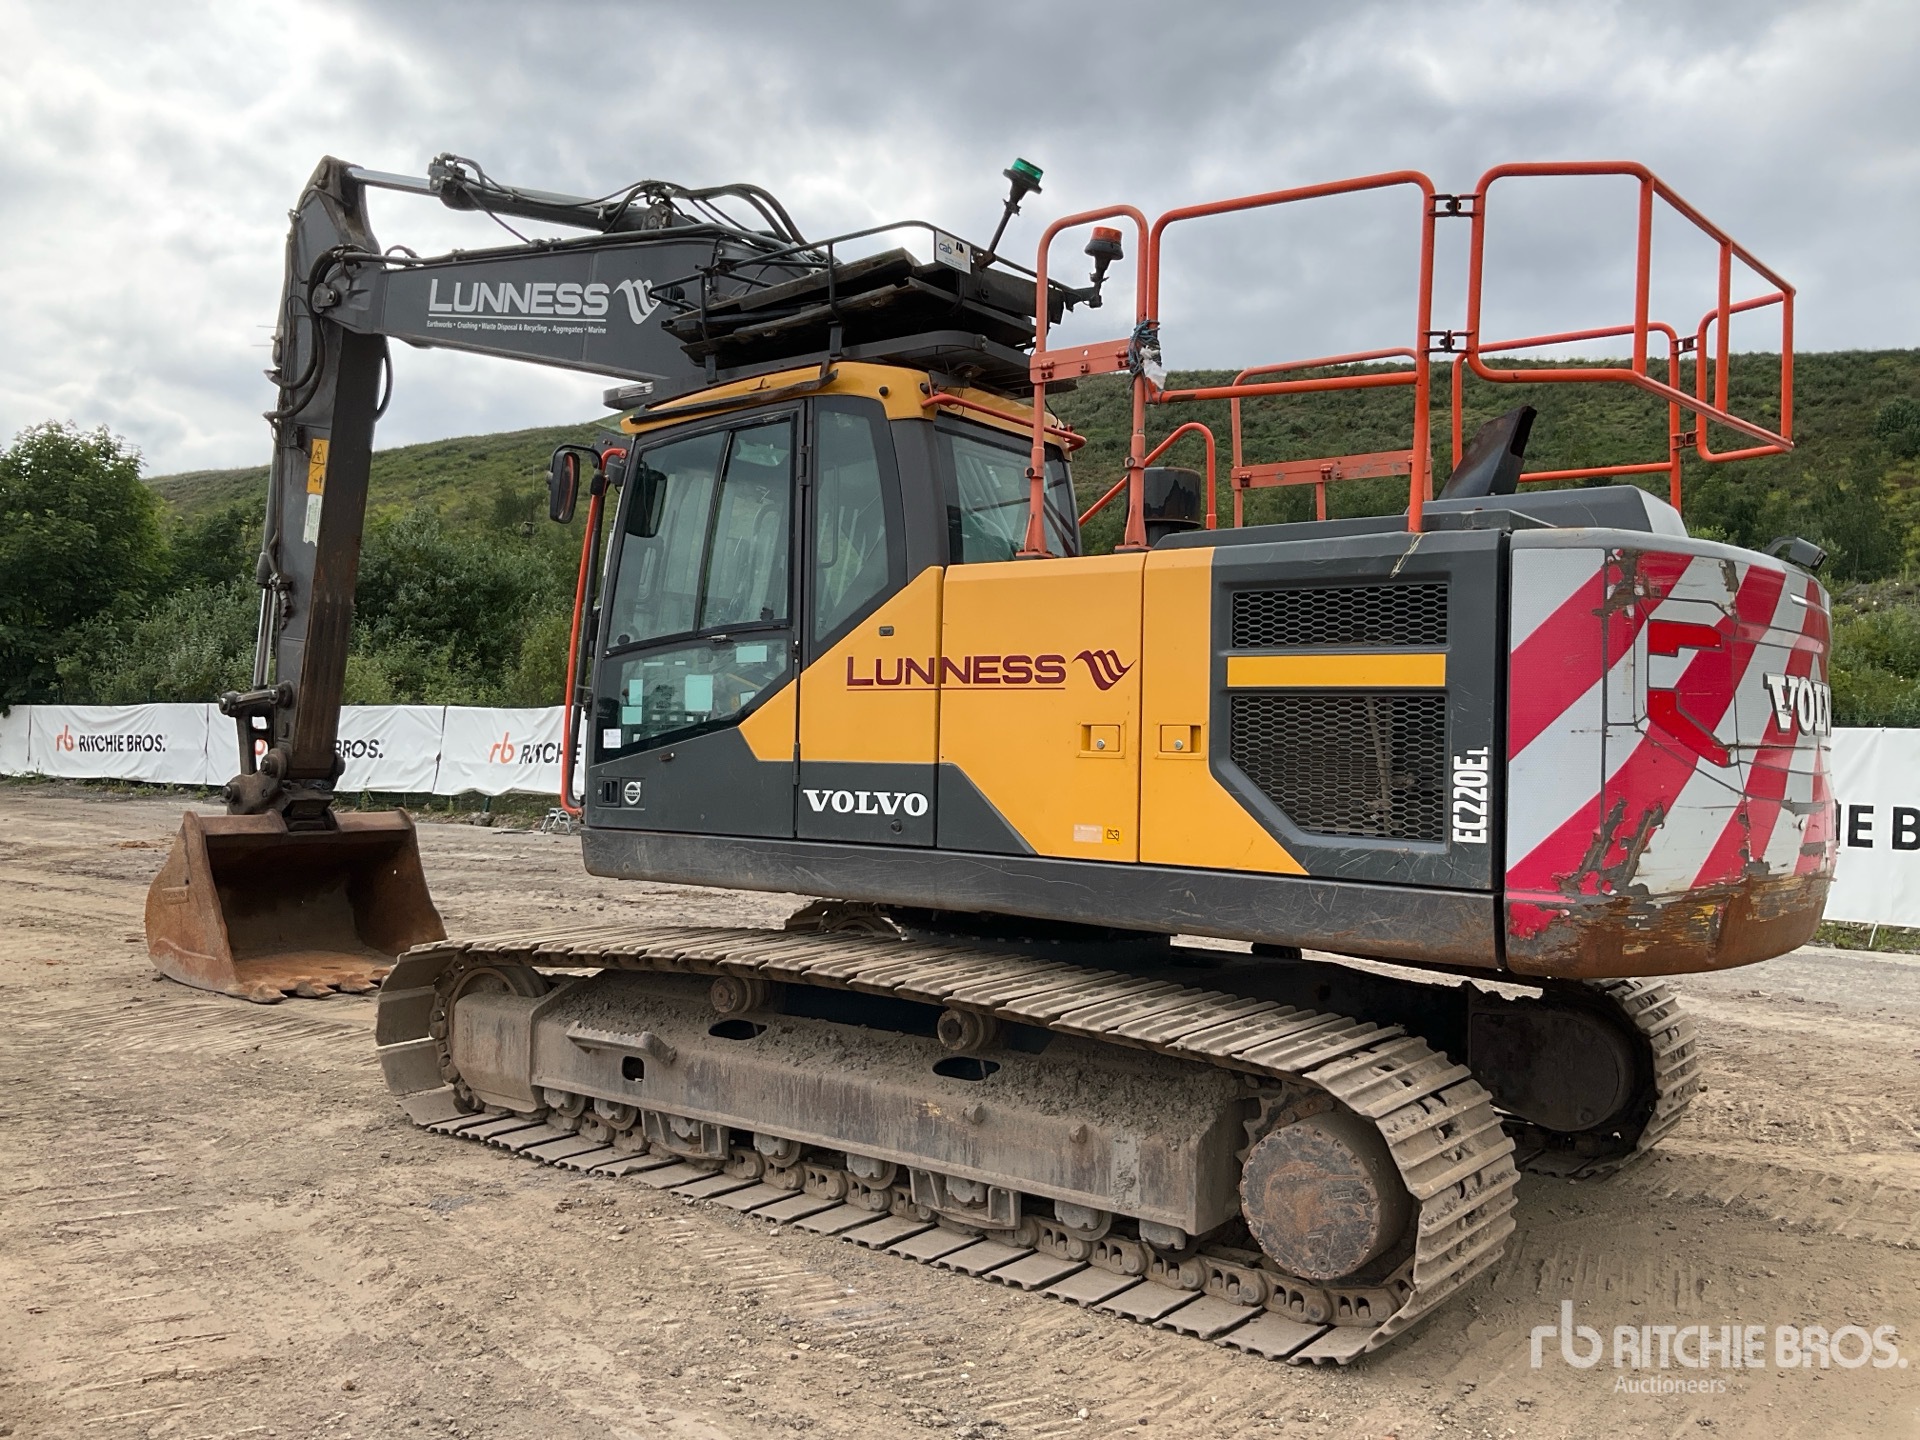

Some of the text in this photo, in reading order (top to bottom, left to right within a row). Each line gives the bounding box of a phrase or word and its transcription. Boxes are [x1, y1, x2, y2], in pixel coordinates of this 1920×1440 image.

[428, 278, 610, 315] LUNNESS
[427, 320, 453, 329] Earthworks
[457, 321, 478, 331] Crushing
[481, 322, 496, 330] Waste
[497, 323, 518, 332] Disposal
[523, 323, 548, 334] Recycling
[552, 325, 584, 335] Aggregates
[588, 326, 607, 334] Marine
[846, 654, 1067, 686] LUNNESS
[78, 734, 124, 752] RITCHIE
[126, 733, 166, 753] BROS.
[518, 742, 582, 765] RITCHE
[803, 789, 929, 817] VOLVO
